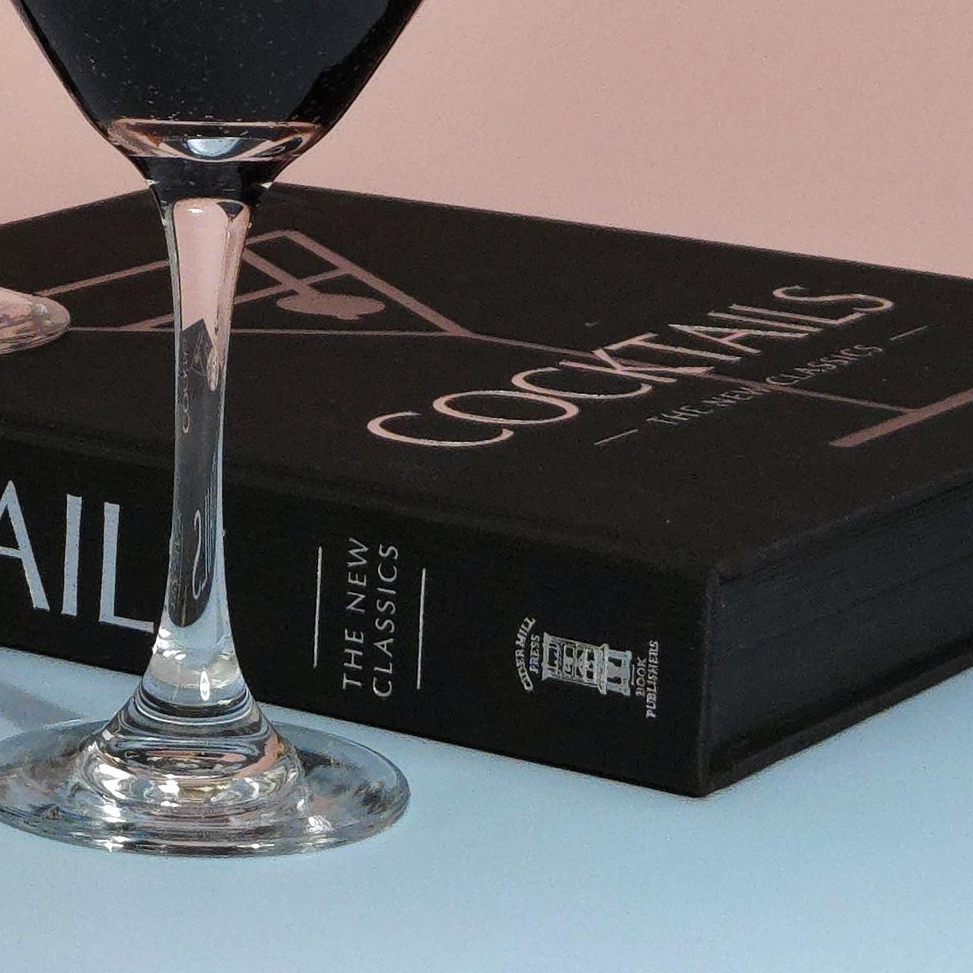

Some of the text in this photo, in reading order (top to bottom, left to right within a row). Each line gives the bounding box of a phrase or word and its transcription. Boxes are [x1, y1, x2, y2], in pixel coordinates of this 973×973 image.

[367, 285, 894, 447] COCKTAILS
[646, 344, 884, 426] THE NEW CLASSICS
[342, 537, 369, 690] THE NEW
[373, 543, 399, 698] CLASSICS
[515, 616, 536, 647] MILL
[529, 634, 541, 675] PRESS
[635, 656, 647, 698] BOOK
[645, 639, 659, 719] PUBLISHERS
